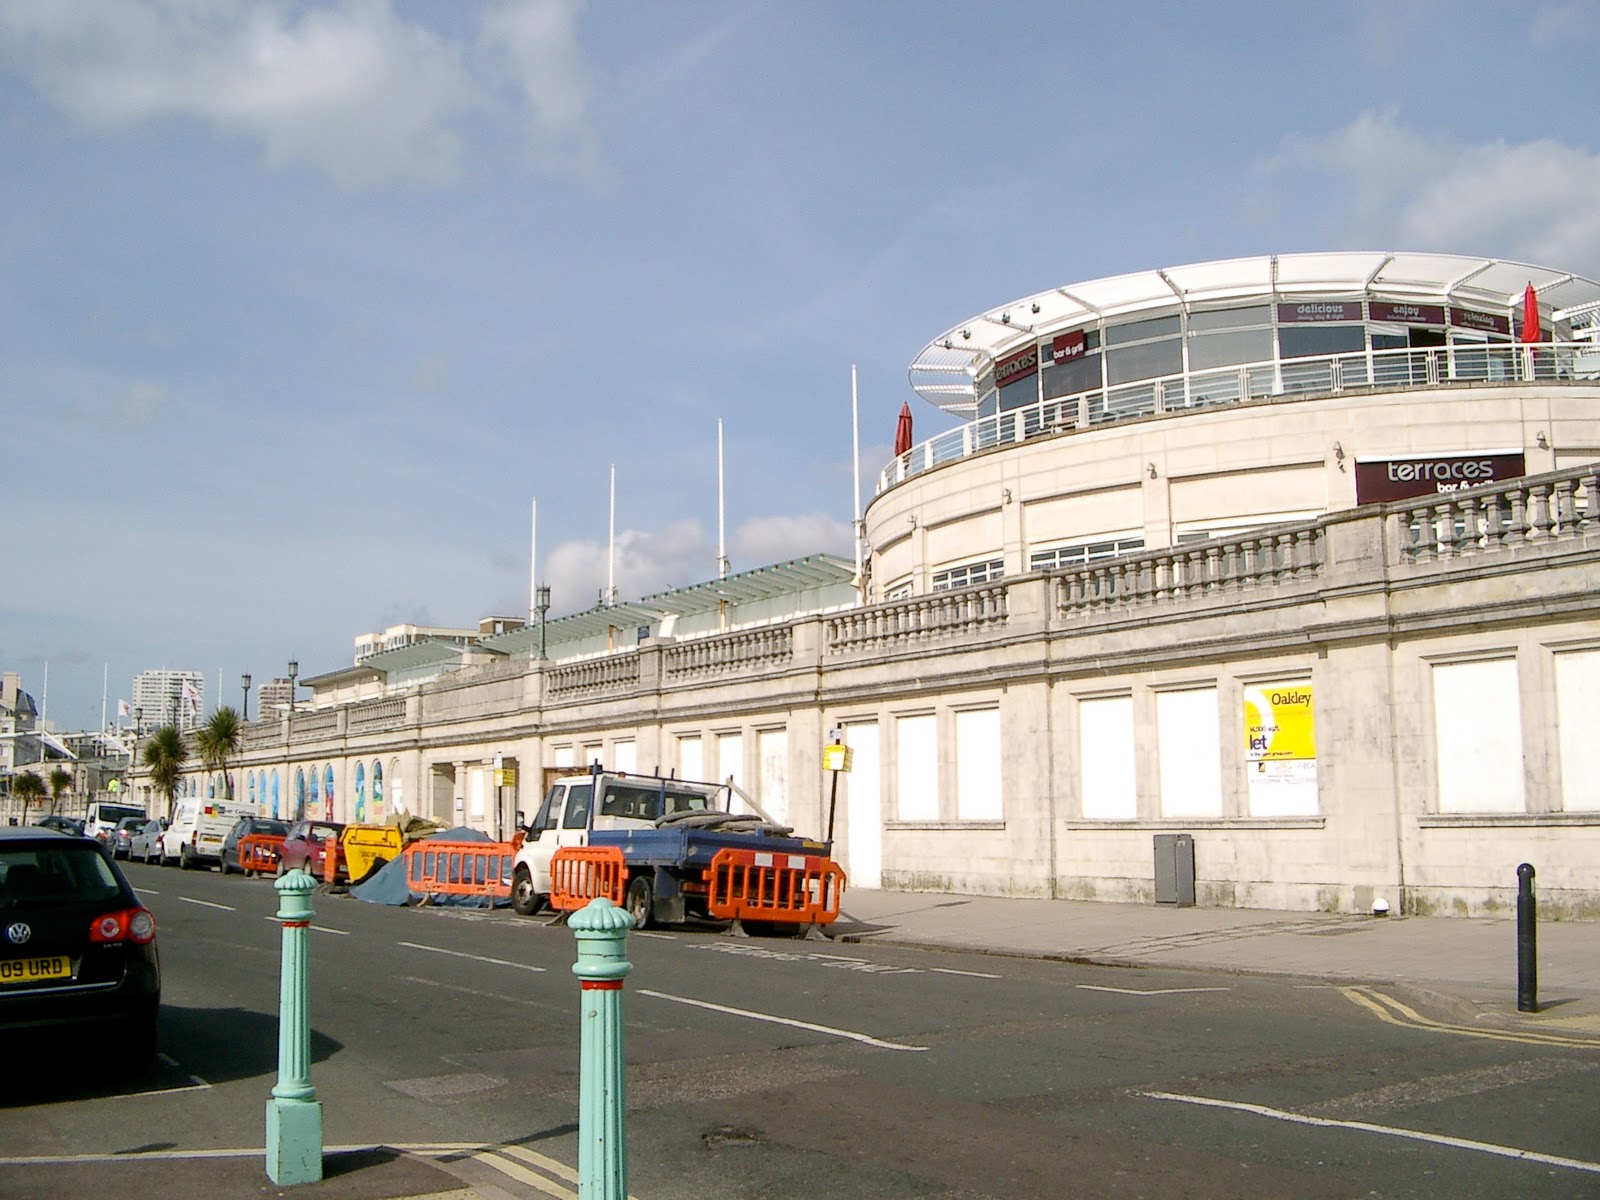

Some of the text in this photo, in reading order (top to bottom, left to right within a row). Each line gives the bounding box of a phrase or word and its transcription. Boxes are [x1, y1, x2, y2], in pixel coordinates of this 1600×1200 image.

[1297, 304, 1343, 313] delicious
[1392, 305, 1419, 316] enjoy
[995, 352, 1036, 379] erraces
[1387, 460, 1494, 481] terraces
[1271, 691, 1312, 707] Oakley
[1249, 734, 1268, 751] let
[0, 959, 63, 978] 09 URD
